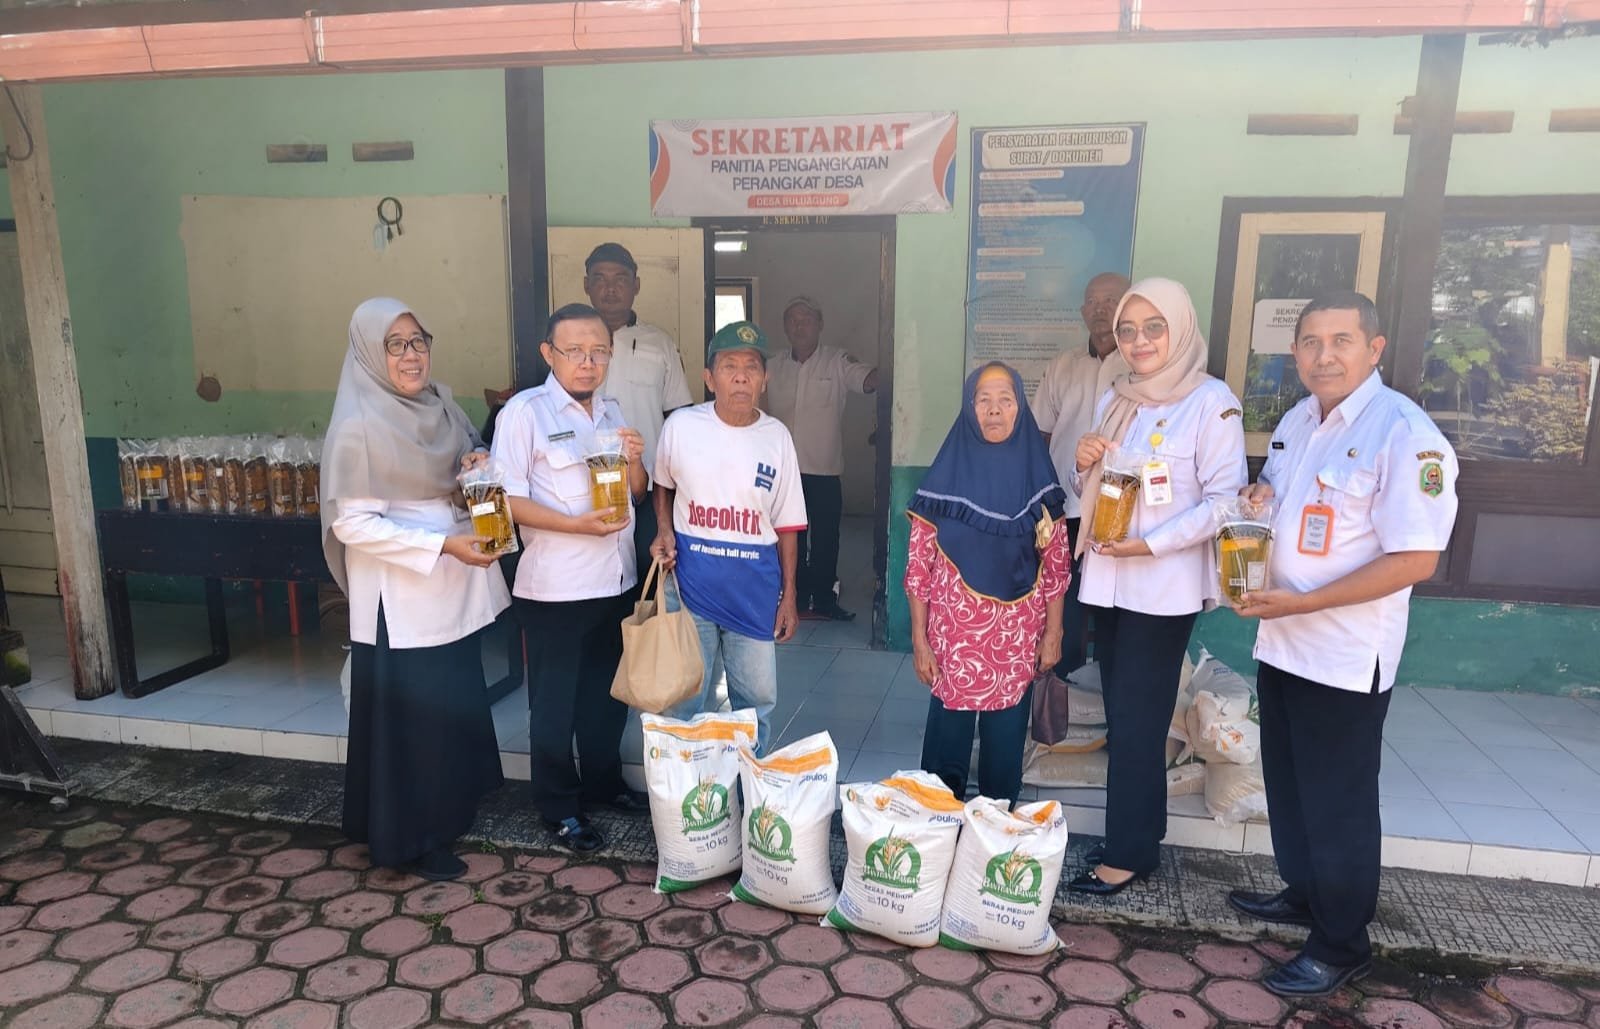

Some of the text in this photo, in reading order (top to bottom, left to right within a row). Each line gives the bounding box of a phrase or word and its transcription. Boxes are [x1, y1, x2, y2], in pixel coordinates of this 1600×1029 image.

[691, 122, 911, 156] SEKRETARIAT
[988, 133, 1057, 149] PERSYARATAN
[711, 156, 889, 173] PANITIA PENGANGKATAN
[733, 174, 864, 191] PERANGKAT DESA
[756, 196, 780, 207] DESA
[705, 836, 728, 850] 10 kg
[763, 868, 774, 880] 10
[775, 873, 788, 885] kg
[877, 896, 905, 914] 10 kg
[997, 913, 1010, 925] 10
[1011, 917, 1026, 930] kg
